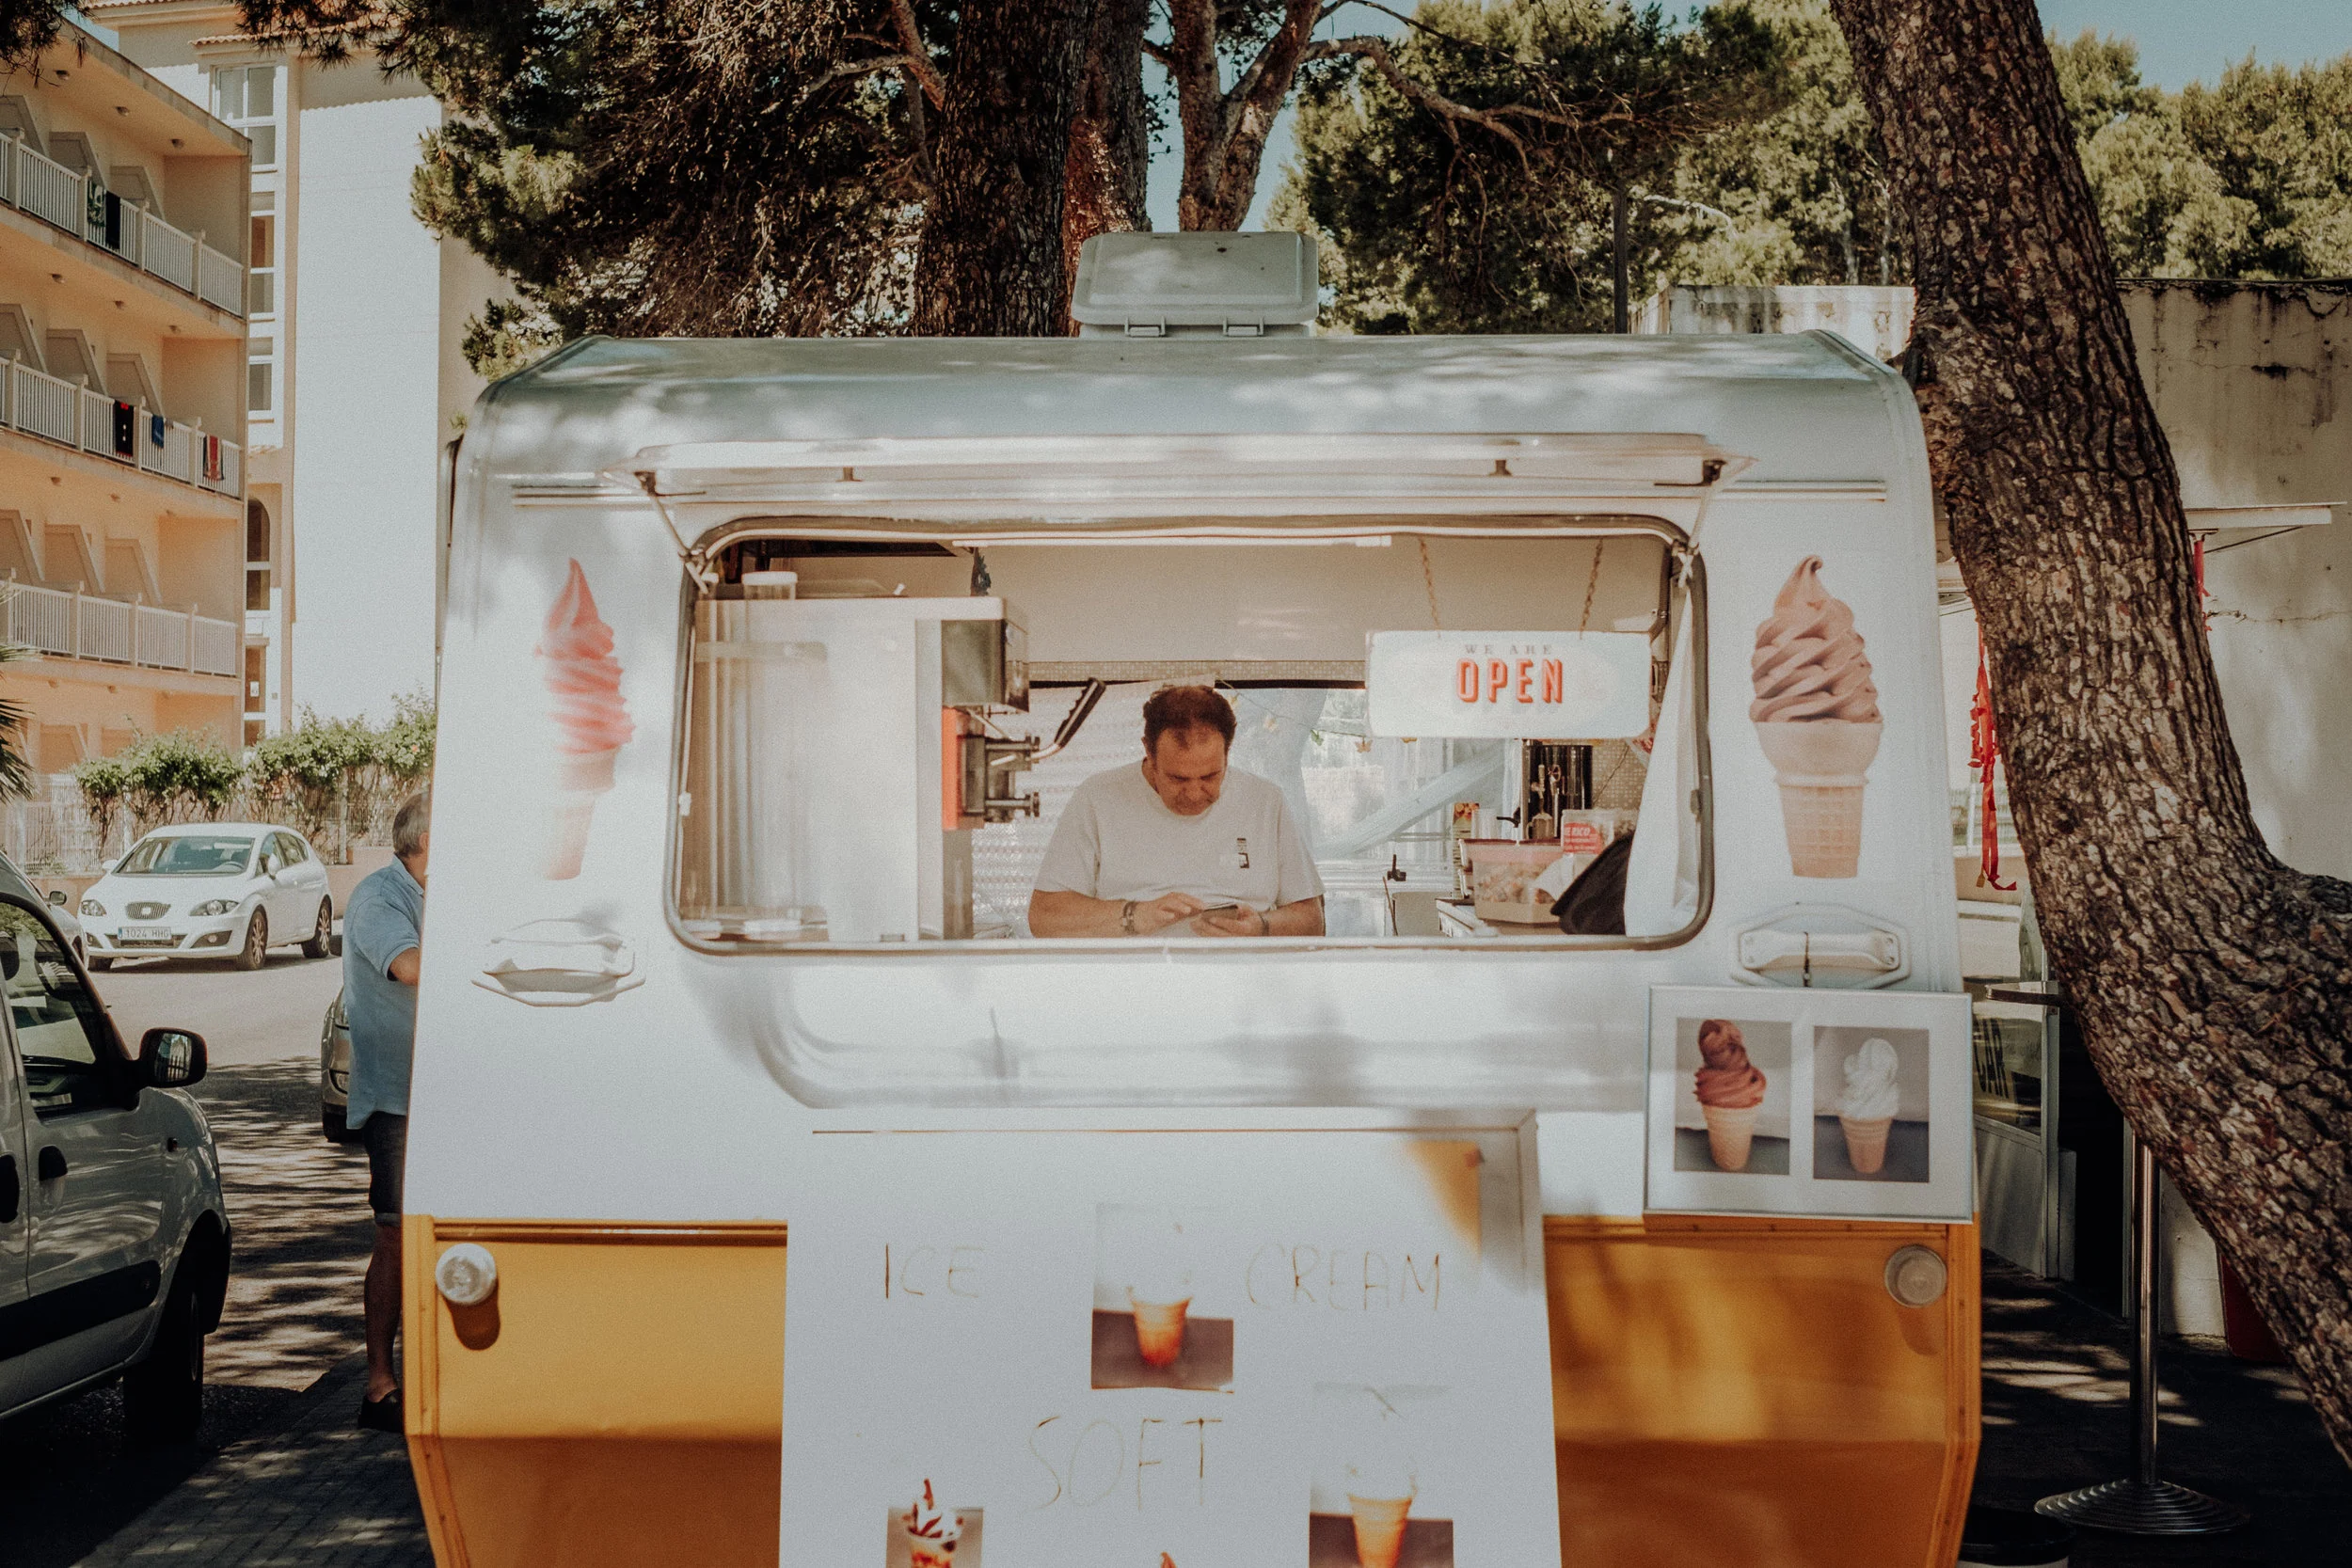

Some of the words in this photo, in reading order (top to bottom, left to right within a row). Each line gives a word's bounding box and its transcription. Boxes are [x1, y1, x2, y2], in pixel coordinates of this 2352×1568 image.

[1465, 644, 1494, 655] WE
[1510, 644, 1552, 655] ARE
[1456, 657, 1563, 704] OPEN
[126, 928, 147, 938] 1024
[883, 1243, 984, 1300] ICE
[1246, 1242, 1441, 1312] CREAM
[1028, 1415, 1224, 1512] SOFT
